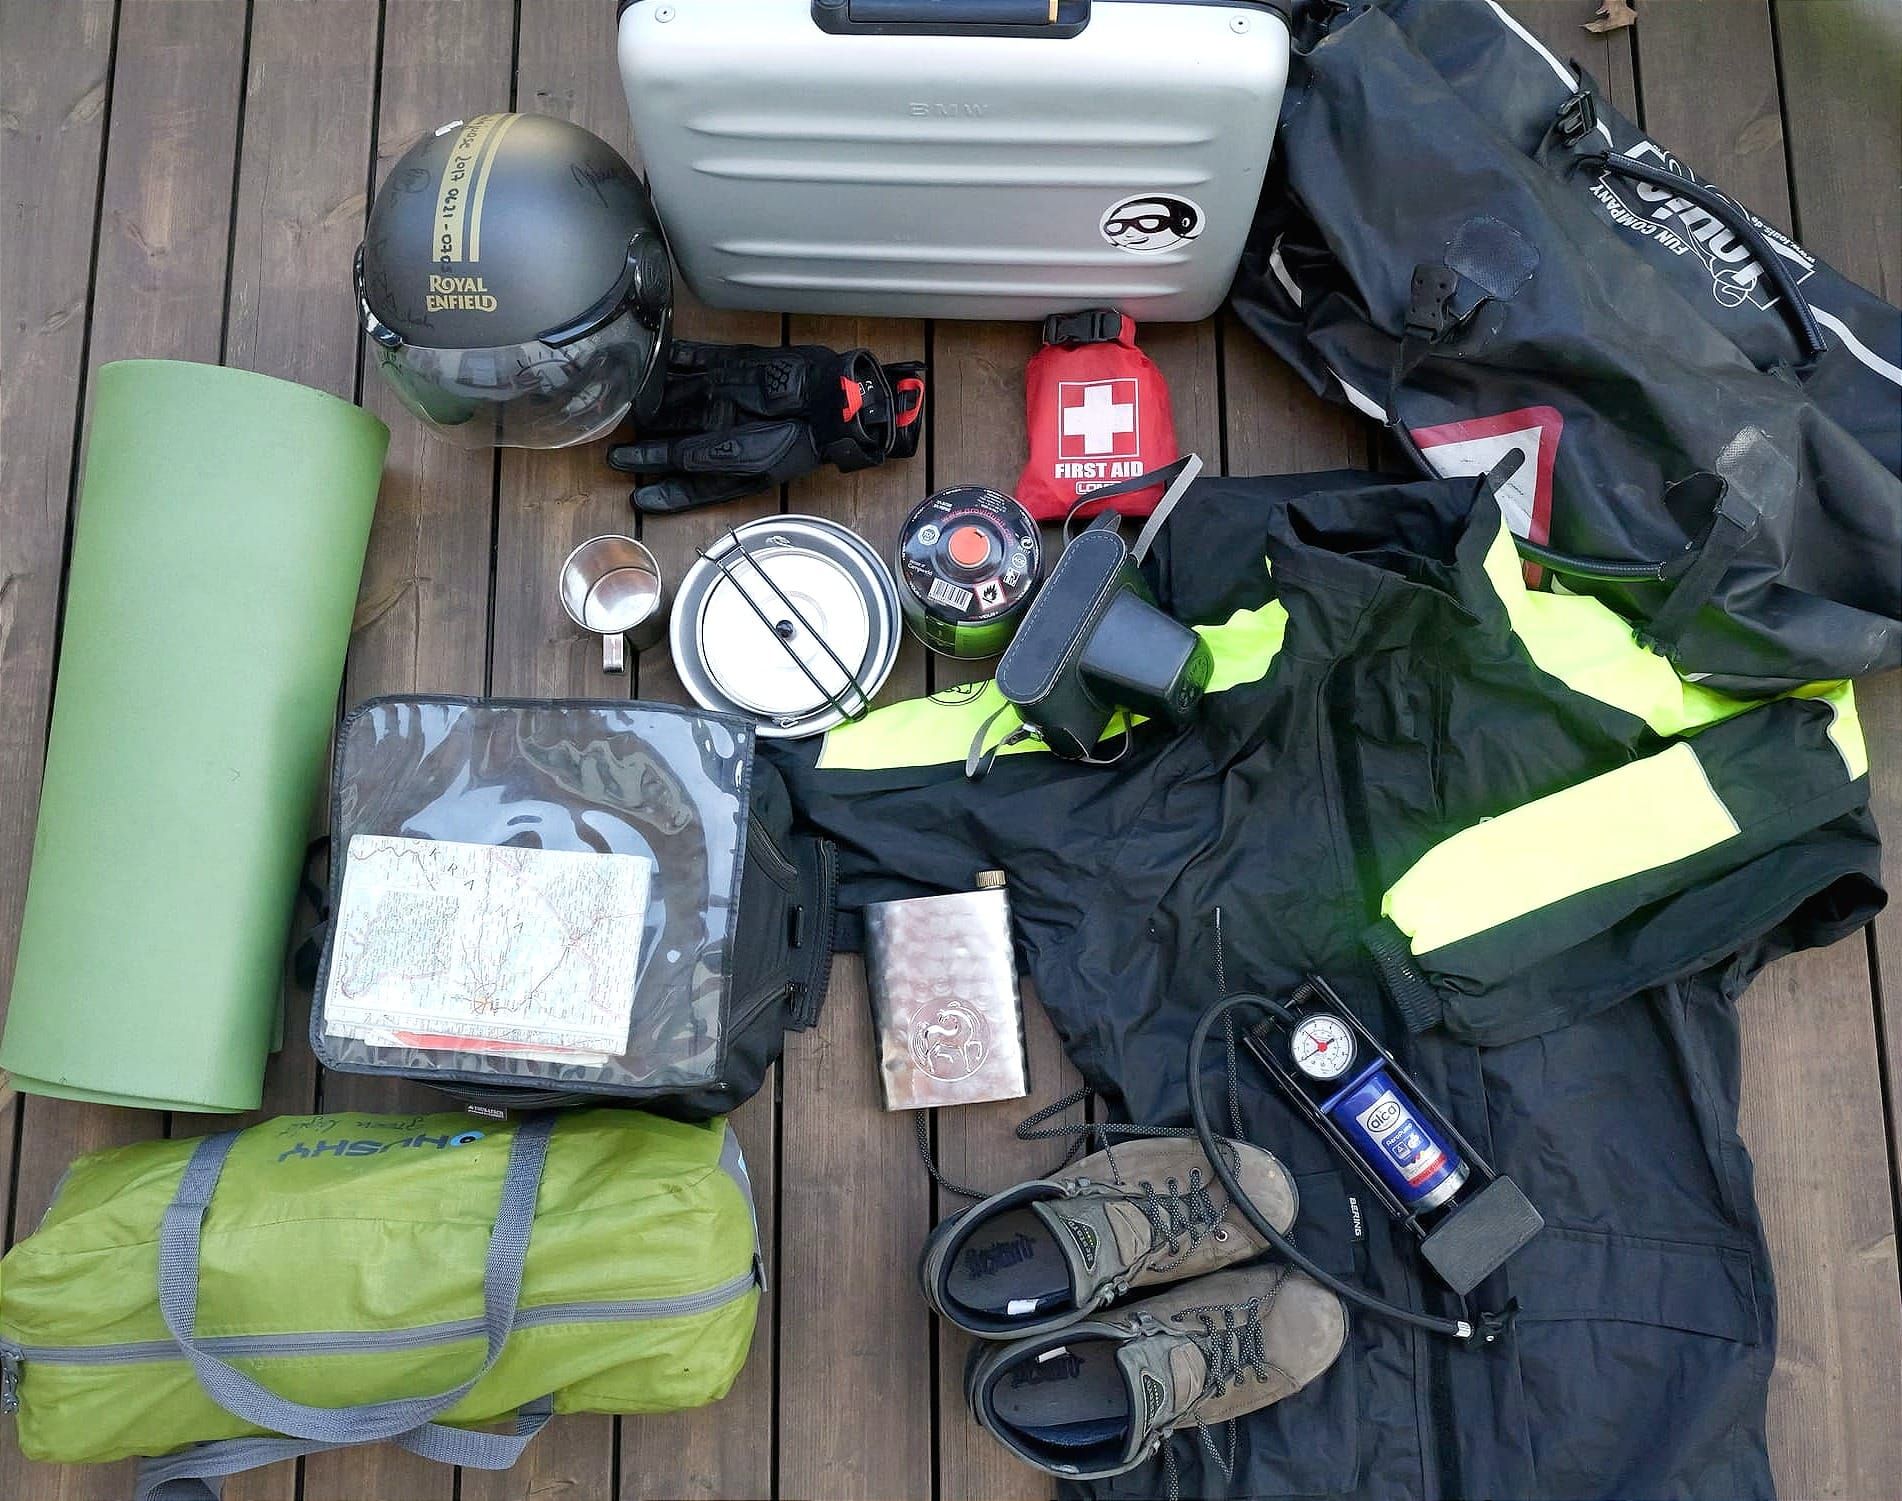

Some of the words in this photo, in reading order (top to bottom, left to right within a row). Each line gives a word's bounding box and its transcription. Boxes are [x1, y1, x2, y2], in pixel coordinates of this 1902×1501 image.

[910, 102, 989, 117] BMW
[450, 155, 471, 182] 2017
[442, 188, 459, 218] 0621
[1589, 184, 1658, 237] COMPANY
[1657, 230, 1690, 256] FUN
[1750, 215, 1816, 263] www.louis.de
[429, 274, 488, 293] ROYAL
[426, 295, 498, 313] ENFIELD
[1055, 461, 1108, 479] FIRST
[1110, 461, 1144, 478] AID
[1370, 1104, 1397, 1129] alca
[278, 1134, 450, 1163] HUSKY
[1348, 1197, 1362, 1237] BERING
